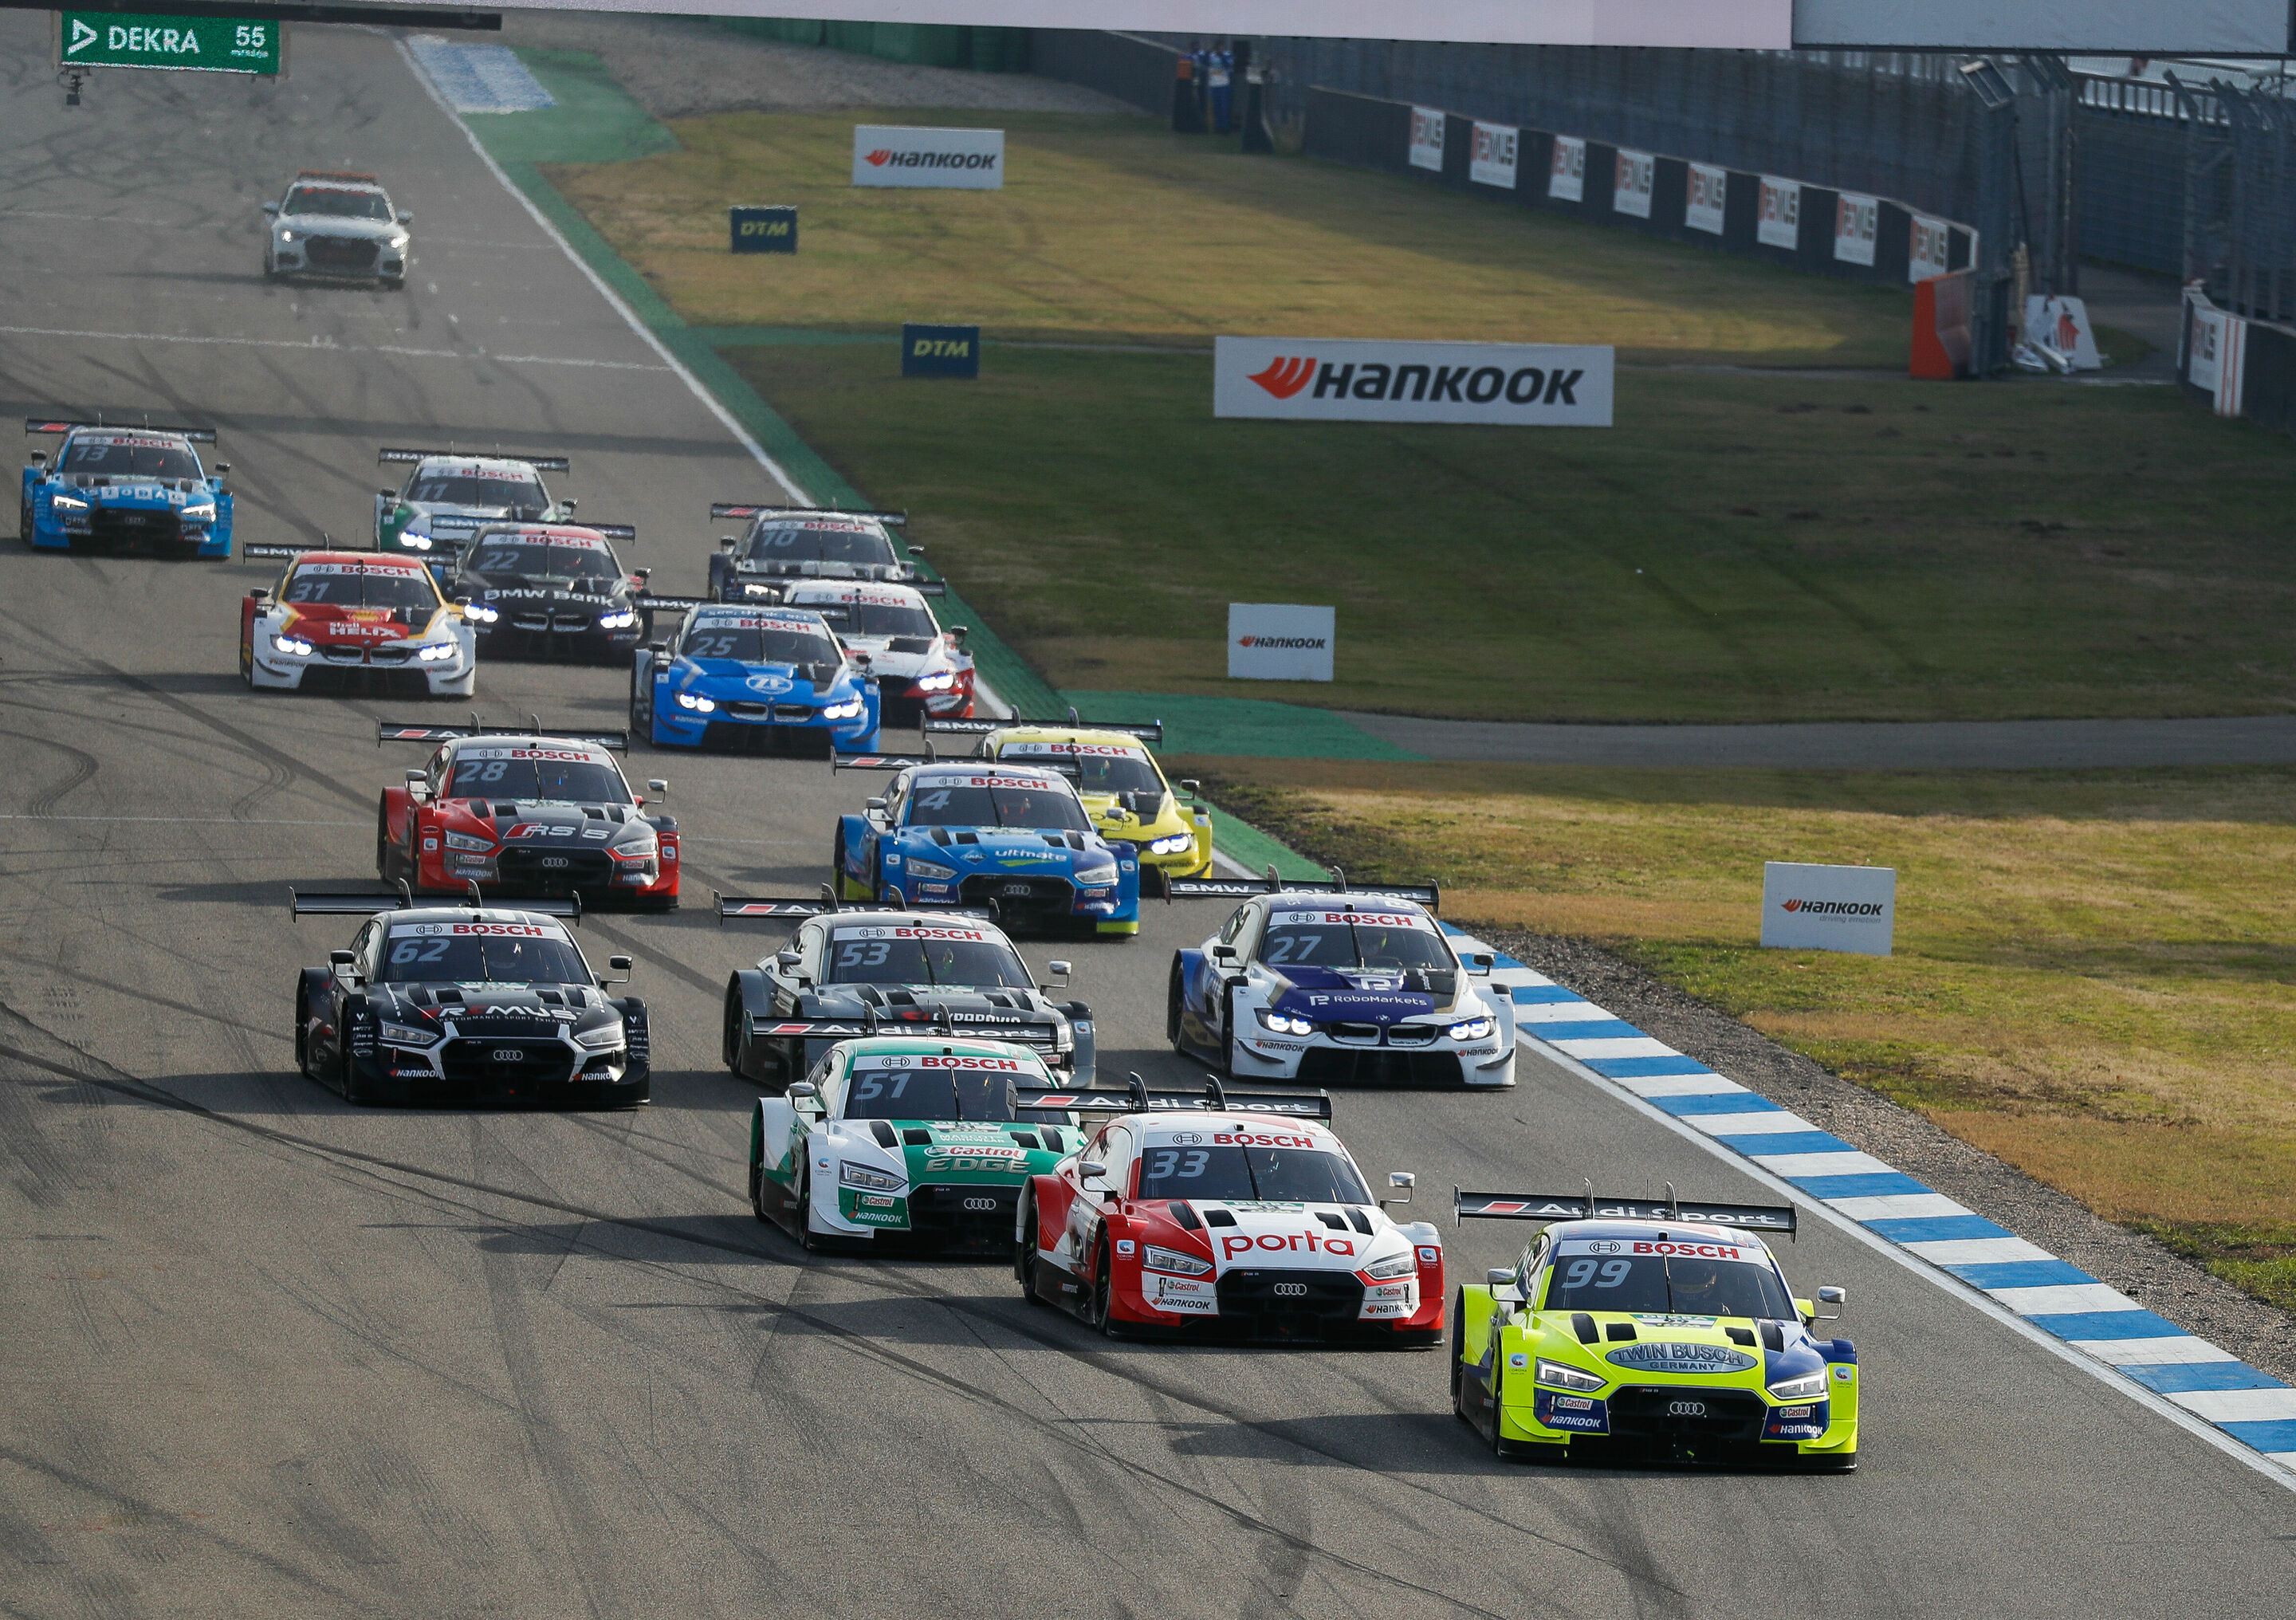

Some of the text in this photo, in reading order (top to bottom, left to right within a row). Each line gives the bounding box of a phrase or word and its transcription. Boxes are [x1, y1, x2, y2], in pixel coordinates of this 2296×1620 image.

[108, 26, 265, 54] DEKRA 55
[741, 221, 789, 237] DTM
[914, 340, 970, 358] DTM
[112, 438, 173, 448] BOSCH
[76, 447, 108, 462] 13
[462, 470, 523, 480] BOSCH
[416, 482, 448, 501] 11
[804, 522, 865, 532] BOSCH
[525, 536, 592, 548] BOSCH
[762, 530, 797, 548] 10
[479, 551, 520, 570] 22
[341, 565, 411, 576] BOSCH
[294, 582, 330, 602] 31
[484, 588, 615, 608] BMW Bank
[840, 594, 906, 606] BOSCH
[740, 619, 810, 632] BOSCH
[329, 627, 401, 639] HELIX
[690, 636, 738, 656] 25
[934, 721, 997, 730] BMW
[511, 749, 590, 761] BOSCH
[1051, 744, 1129, 756] BOSCH
[455, 761, 509, 784] 28
[971, 777, 1048, 789] BOSCH
[918, 789, 952, 810] 4
[522, 825, 611, 839] RS 5
[995, 849, 1067, 863] ultimate
[1178, 883, 1249, 894] BMW
[1325, 913, 1413, 926] BOSCH
[453, 924, 543, 936] BOSCH
[895, 927, 984, 941] BOSCH
[391, 938, 451, 964] 62
[838, 942, 891, 967] 53
[1268, 935, 1323, 963] 27
[1334, 995, 1428, 1006] RoboMarkets
[438, 1005, 578, 1020] REMUS
[438, 1014, 501, 1023] PERFORMANCE
[926, 1026, 1040, 1037] Sport
[922, 1056, 1019, 1071] BOSCH
[854, 1073, 911, 1100] 51
[1193, 1099, 1309, 1111] Sport
[1213, 1133, 1315, 1149] BOSCH
[949, 1146, 1020, 1158] Castrol
[925, 1158, 1032, 1174] EDGE
[1147, 1150, 1210, 1179] 33
[869, 1197, 892, 1205] Castrol
[1648, 1207, 1777, 1225] Sport
[1221, 1230, 1355, 1260] porta
[1633, 1242, 1740, 1260] BOSCH
[1561, 1259, 1632, 1288] 99
[1174, 1282, 1201, 1292] Castrol
[1382, 1287, 1402, 1296] Castrol
[1614, 1343, 1744, 1365] TWIN BUSCH
[1649, 1362, 1716, 1371] GERMANY
[1565, 1398, 1591, 1410] Castrol
[1787, 1408, 1809, 1417] Castrol
